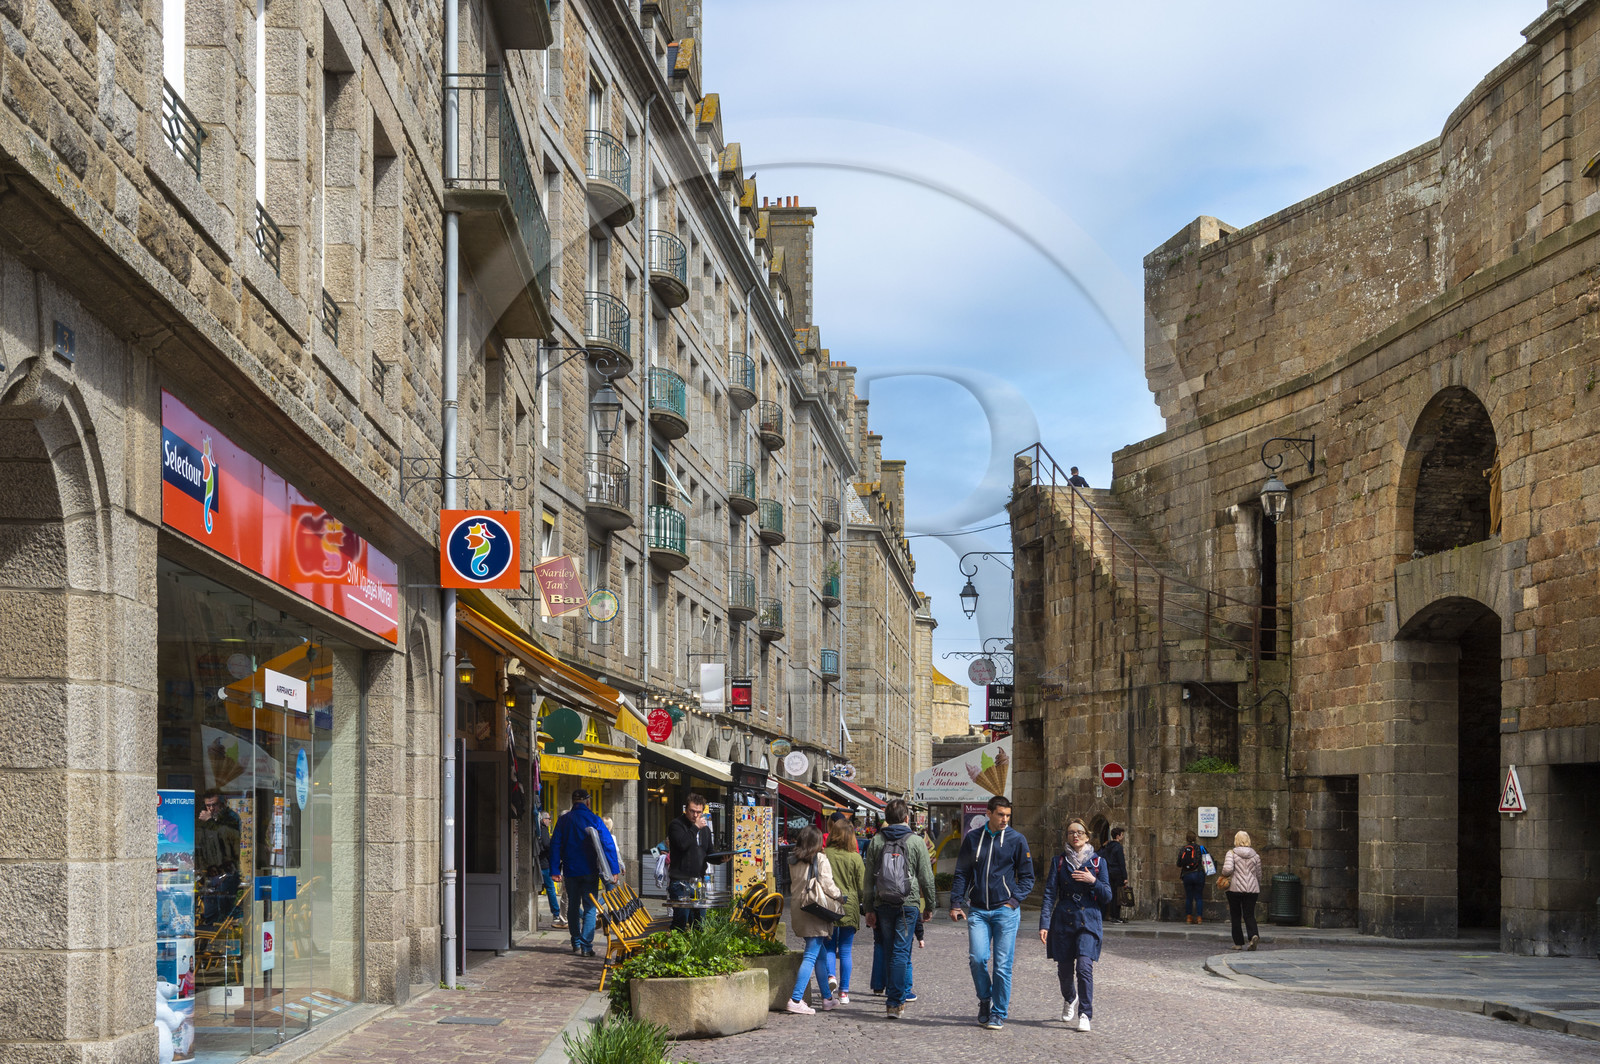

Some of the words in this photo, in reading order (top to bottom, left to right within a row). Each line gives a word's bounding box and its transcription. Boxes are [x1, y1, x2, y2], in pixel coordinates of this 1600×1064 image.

[165, 440, 201, 487] Selectour
[359, 567, 378, 600] Voyages
[545, 581, 569, 590] Tan's
[549, 594, 584, 605] Bar
[996, 686, 1005, 695] BAR
[990, 711, 1010, 720] PIZZERIA
[659, 771, 680, 780] SIMON
[931, 767, 959, 778] Glaces
